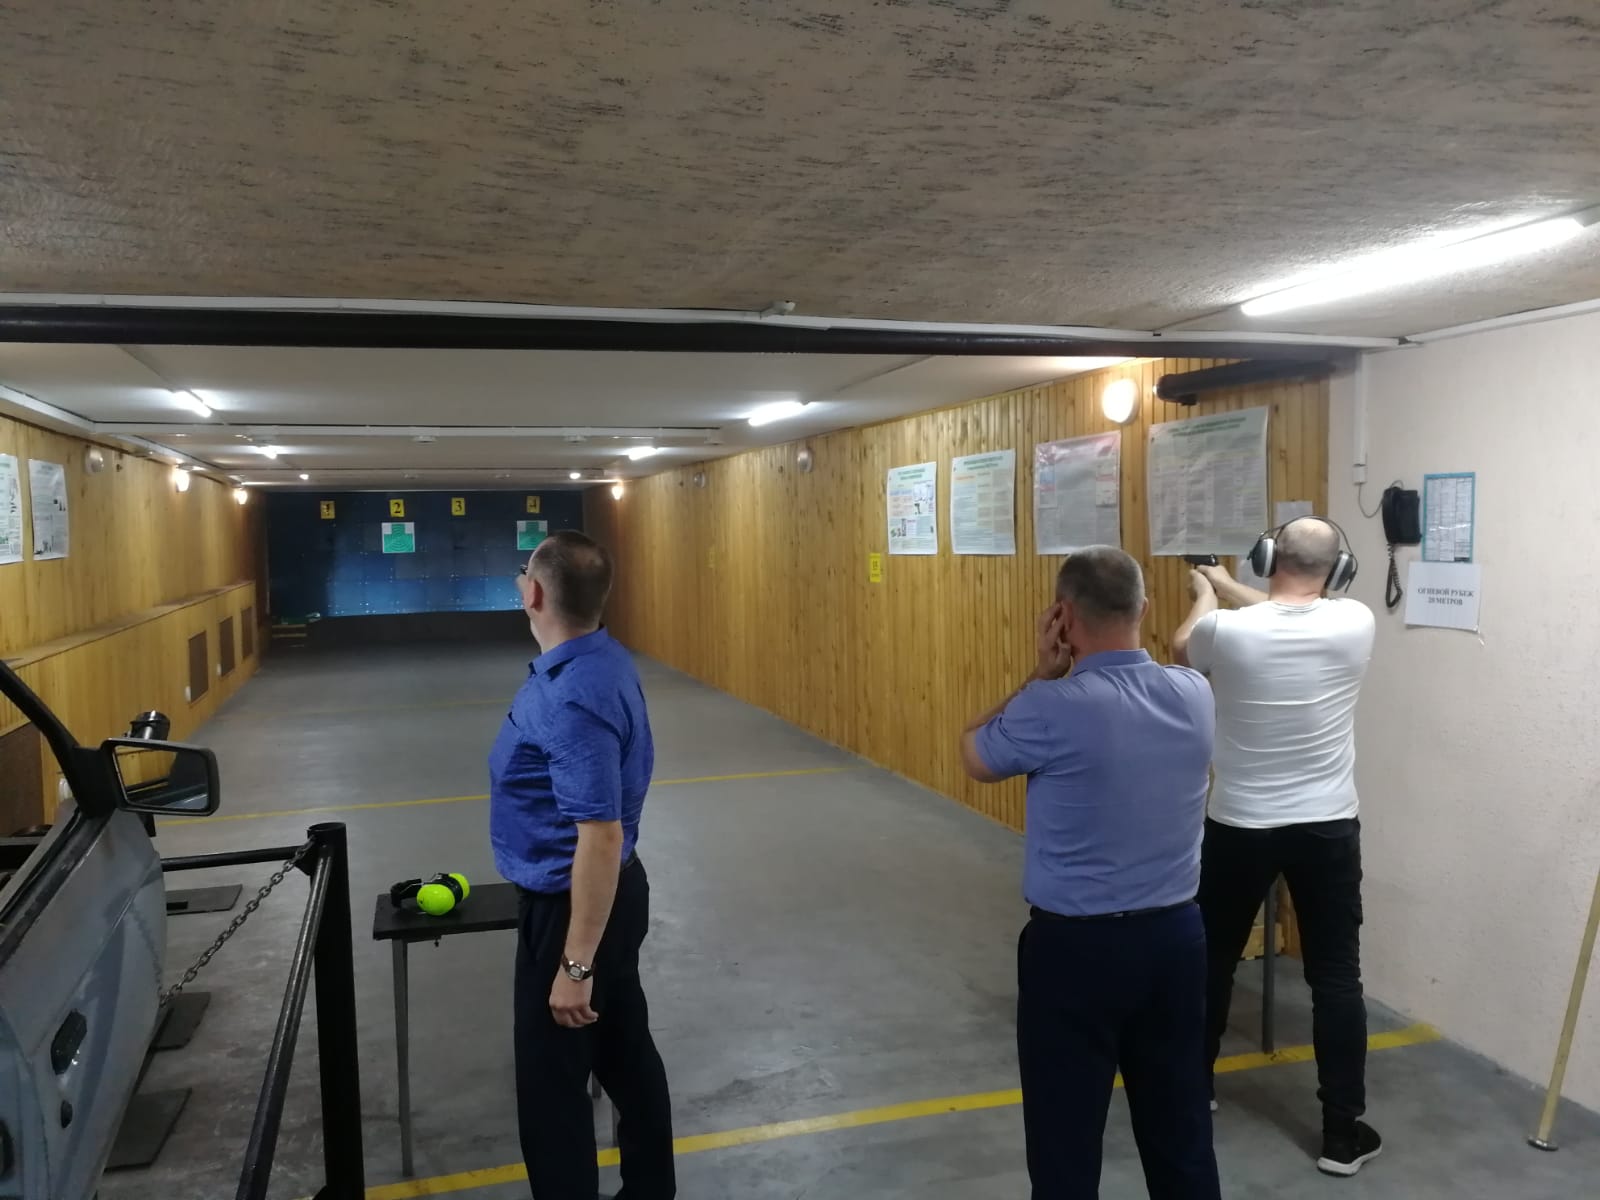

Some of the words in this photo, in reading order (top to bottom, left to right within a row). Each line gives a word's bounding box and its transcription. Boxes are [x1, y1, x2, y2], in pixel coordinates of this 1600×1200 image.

[393, 502, 401, 514] 2
[455, 500, 463, 513] 3
[1417, 587, 1450, 596] ОГНЕВОЙ
[1451, 589, 1474, 598] РУБЕЖ
[1436, 597, 1463, 606] МЕТРОВ
